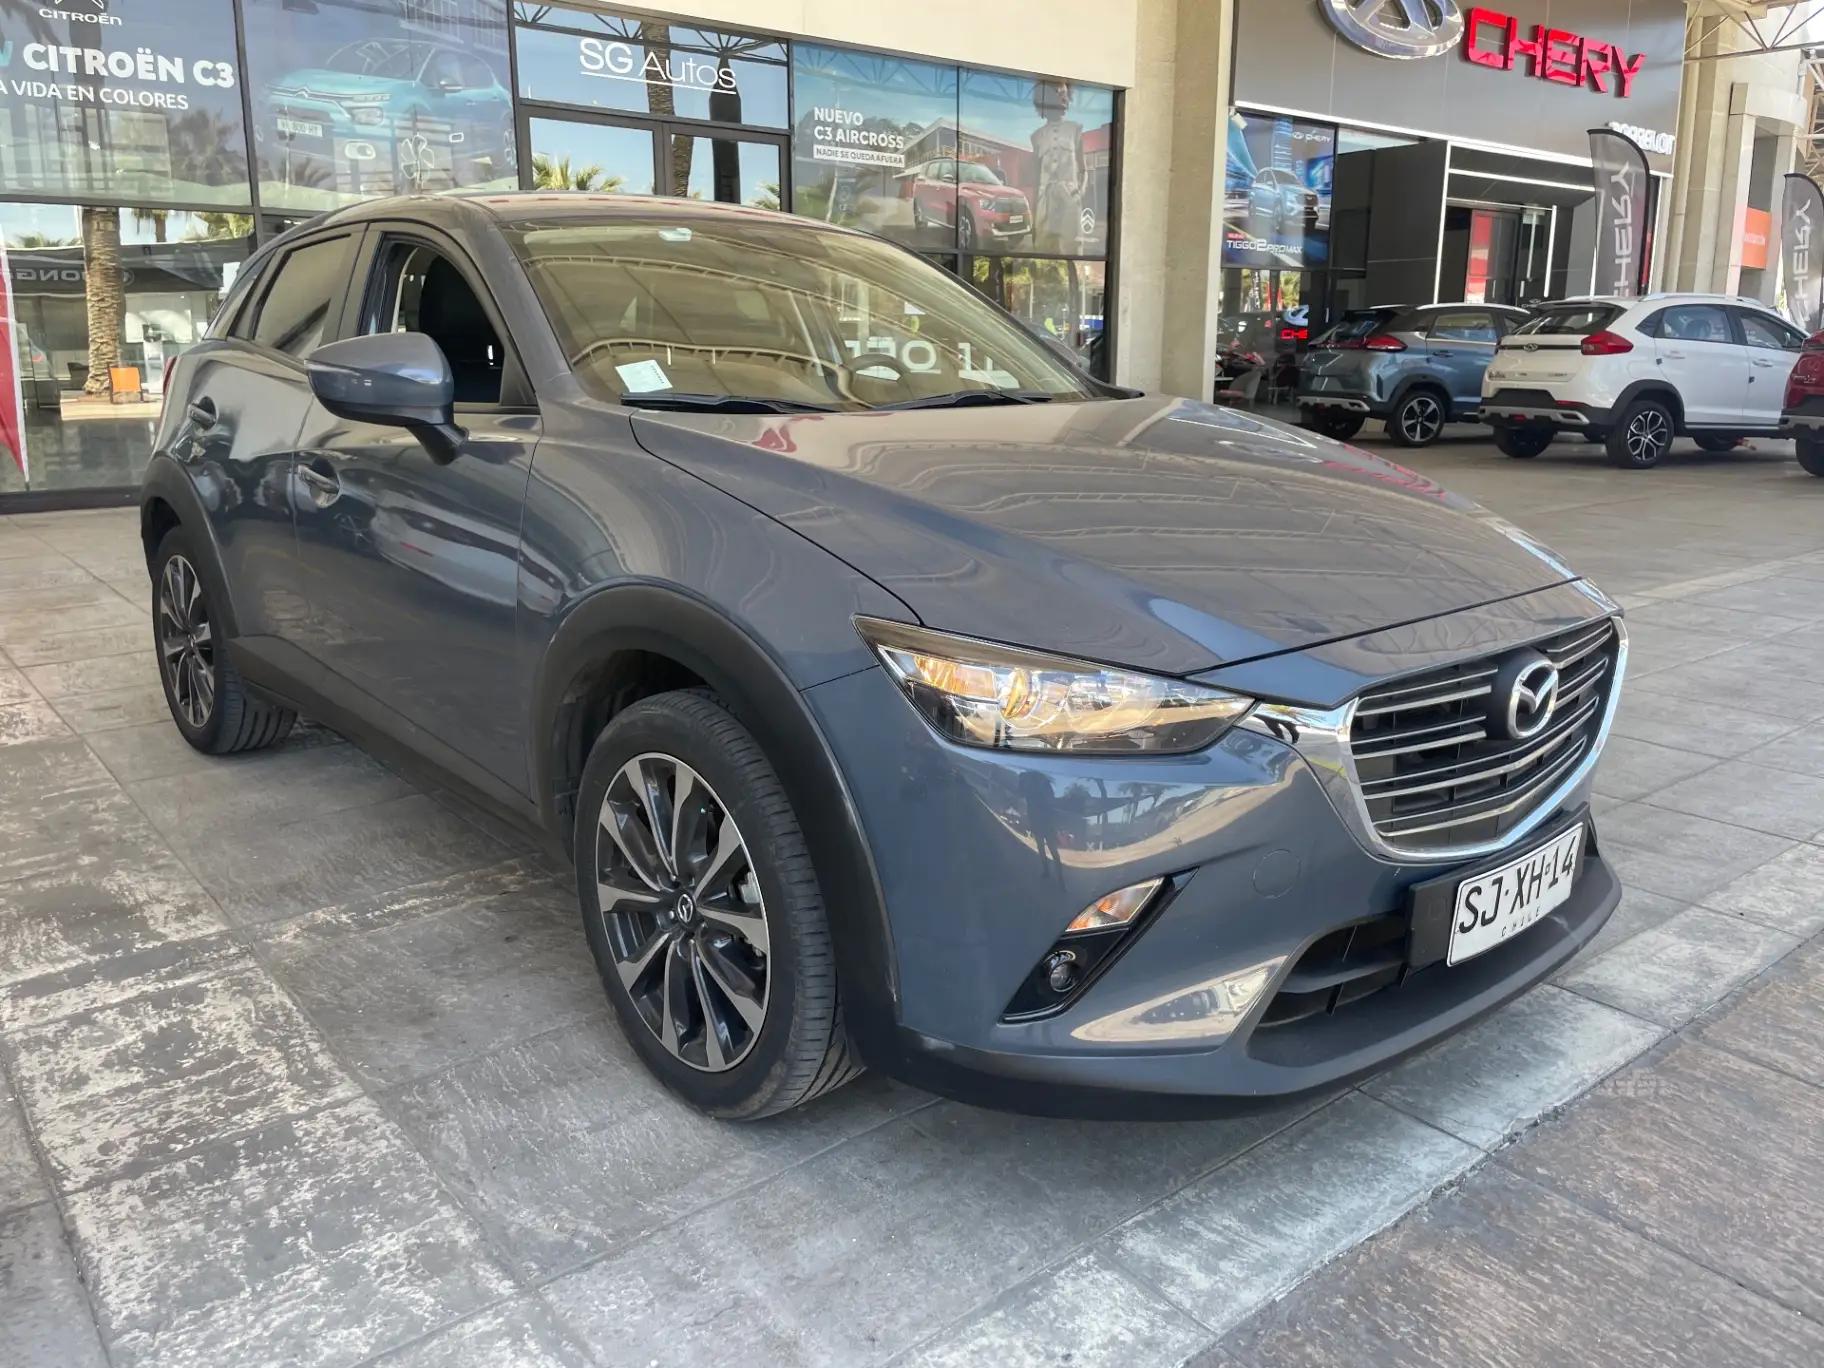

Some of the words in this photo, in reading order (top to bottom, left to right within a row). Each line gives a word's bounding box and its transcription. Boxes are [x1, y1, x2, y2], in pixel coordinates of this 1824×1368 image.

[23, 43, 185, 83] CITROËN
[192, 60, 235, 88] C3
[580, 38, 633, 73] SG
[638, 51, 737, 88] Autos
[1467, 7, 1646, 98] CHERY
[11, 80, 62, 99] VIDA
[67, 86, 95, 102] EN
[100, 88, 189, 110] COLORES
[814, 106, 864, 126] NUEVO
[814, 126, 833, 140] C3
[836, 128, 904, 149] AIRCROSS
[850, 151, 875, 161] QUEDA
[1611, 160, 1632, 297] HERY
